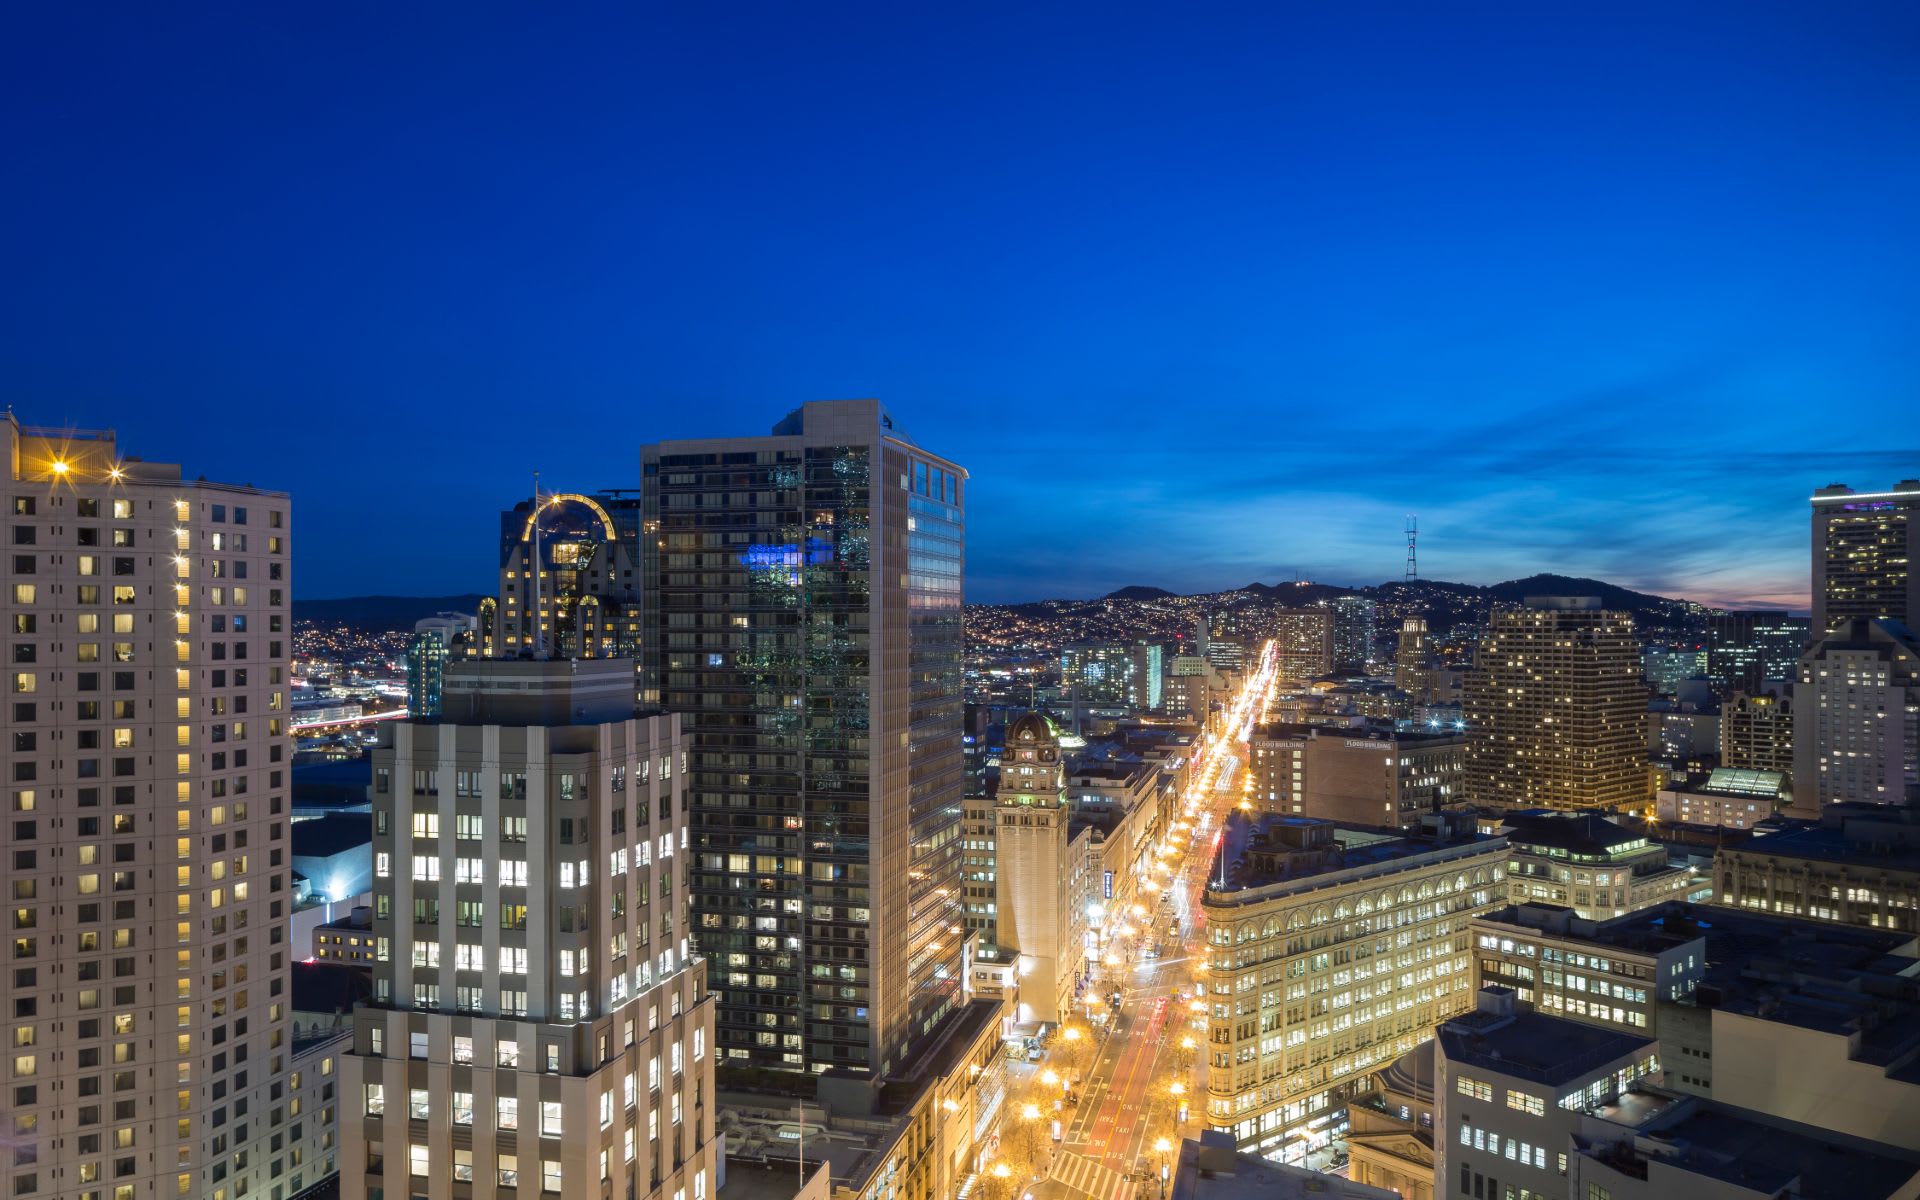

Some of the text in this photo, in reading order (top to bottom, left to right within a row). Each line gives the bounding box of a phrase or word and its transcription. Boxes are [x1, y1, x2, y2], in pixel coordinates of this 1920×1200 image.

[1346, 740, 1392, 749] FLOOD BUILDING
[1122, 1103, 1138, 1111] ONLY
[1100, 1115, 1114, 1123] TAXI
[1115, 1126, 1129, 1134] TAXI
[1106, 1151, 1124, 1160] BUS
